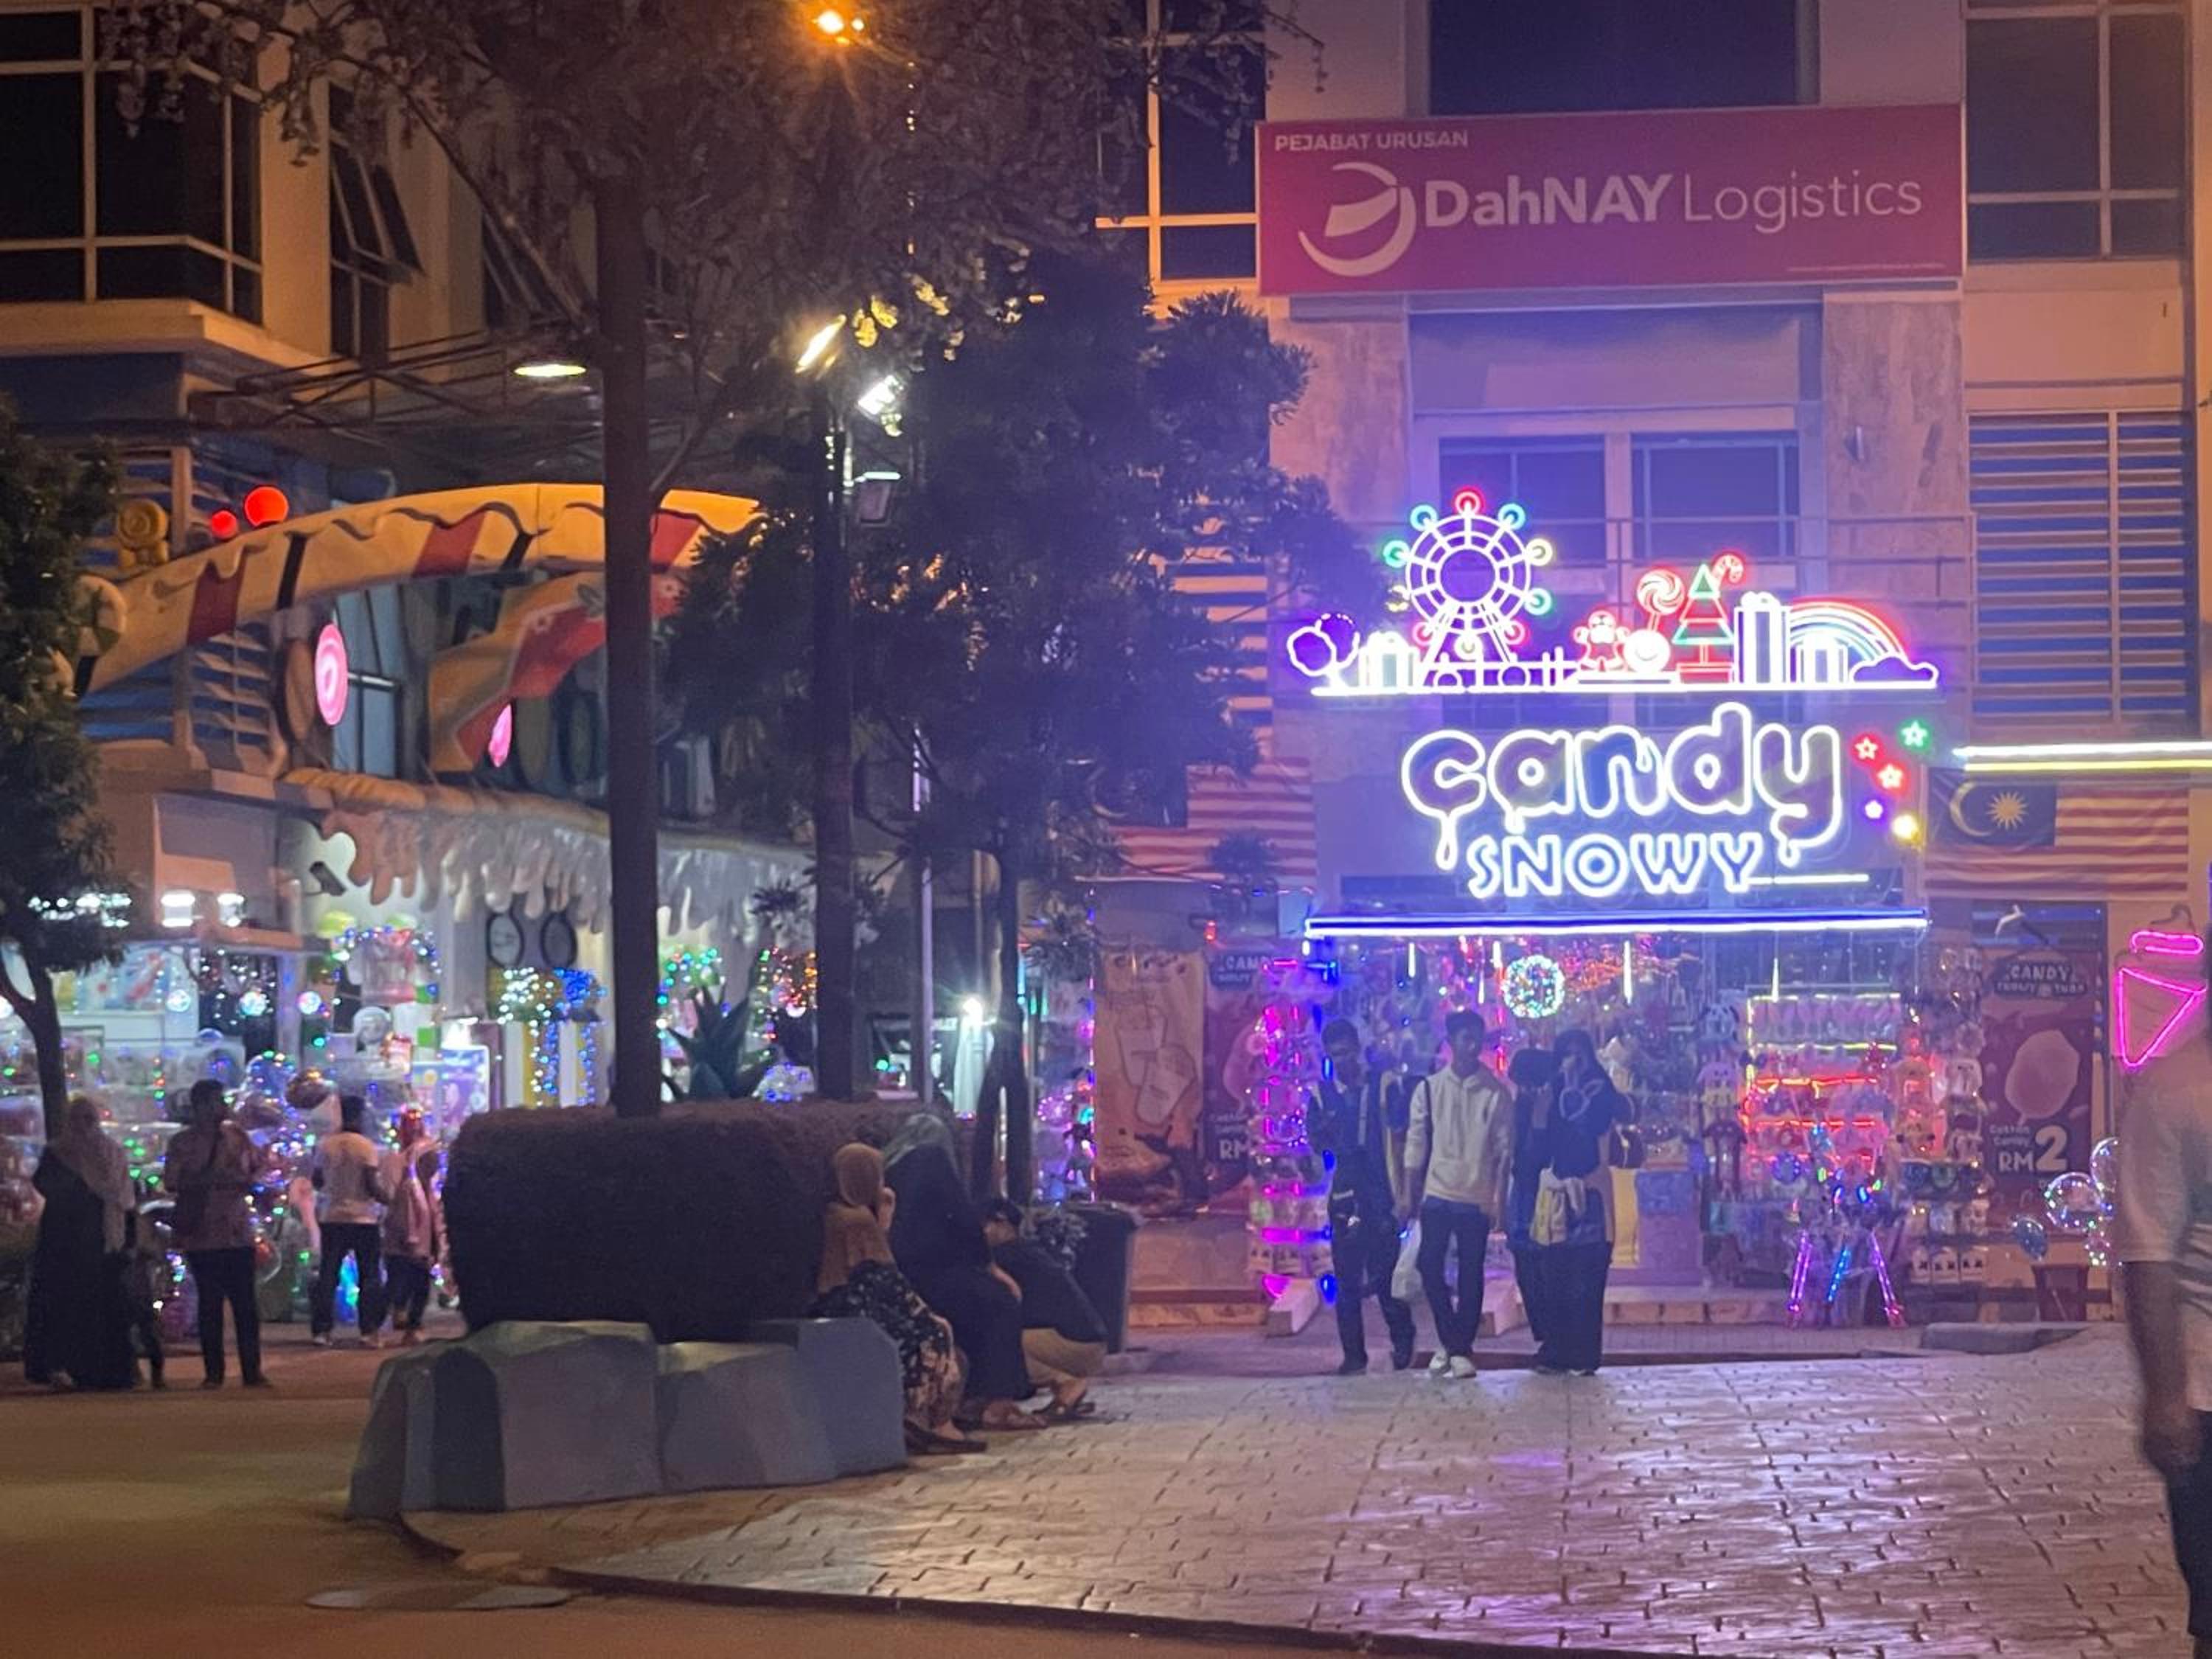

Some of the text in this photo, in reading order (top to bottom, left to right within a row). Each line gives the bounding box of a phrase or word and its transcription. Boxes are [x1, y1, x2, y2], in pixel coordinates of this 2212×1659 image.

[1275, 131, 1469, 151] PEJABAT URUSAN
[1425, 170, 1923, 234] DahNAY Logistics
[1402, 701, 1842, 870] candy
[1467, 835, 1762, 899] SNOWY
[2009, 964, 2069, 981] CANDY
[1998, 1125, 2067, 1172] RM 2
